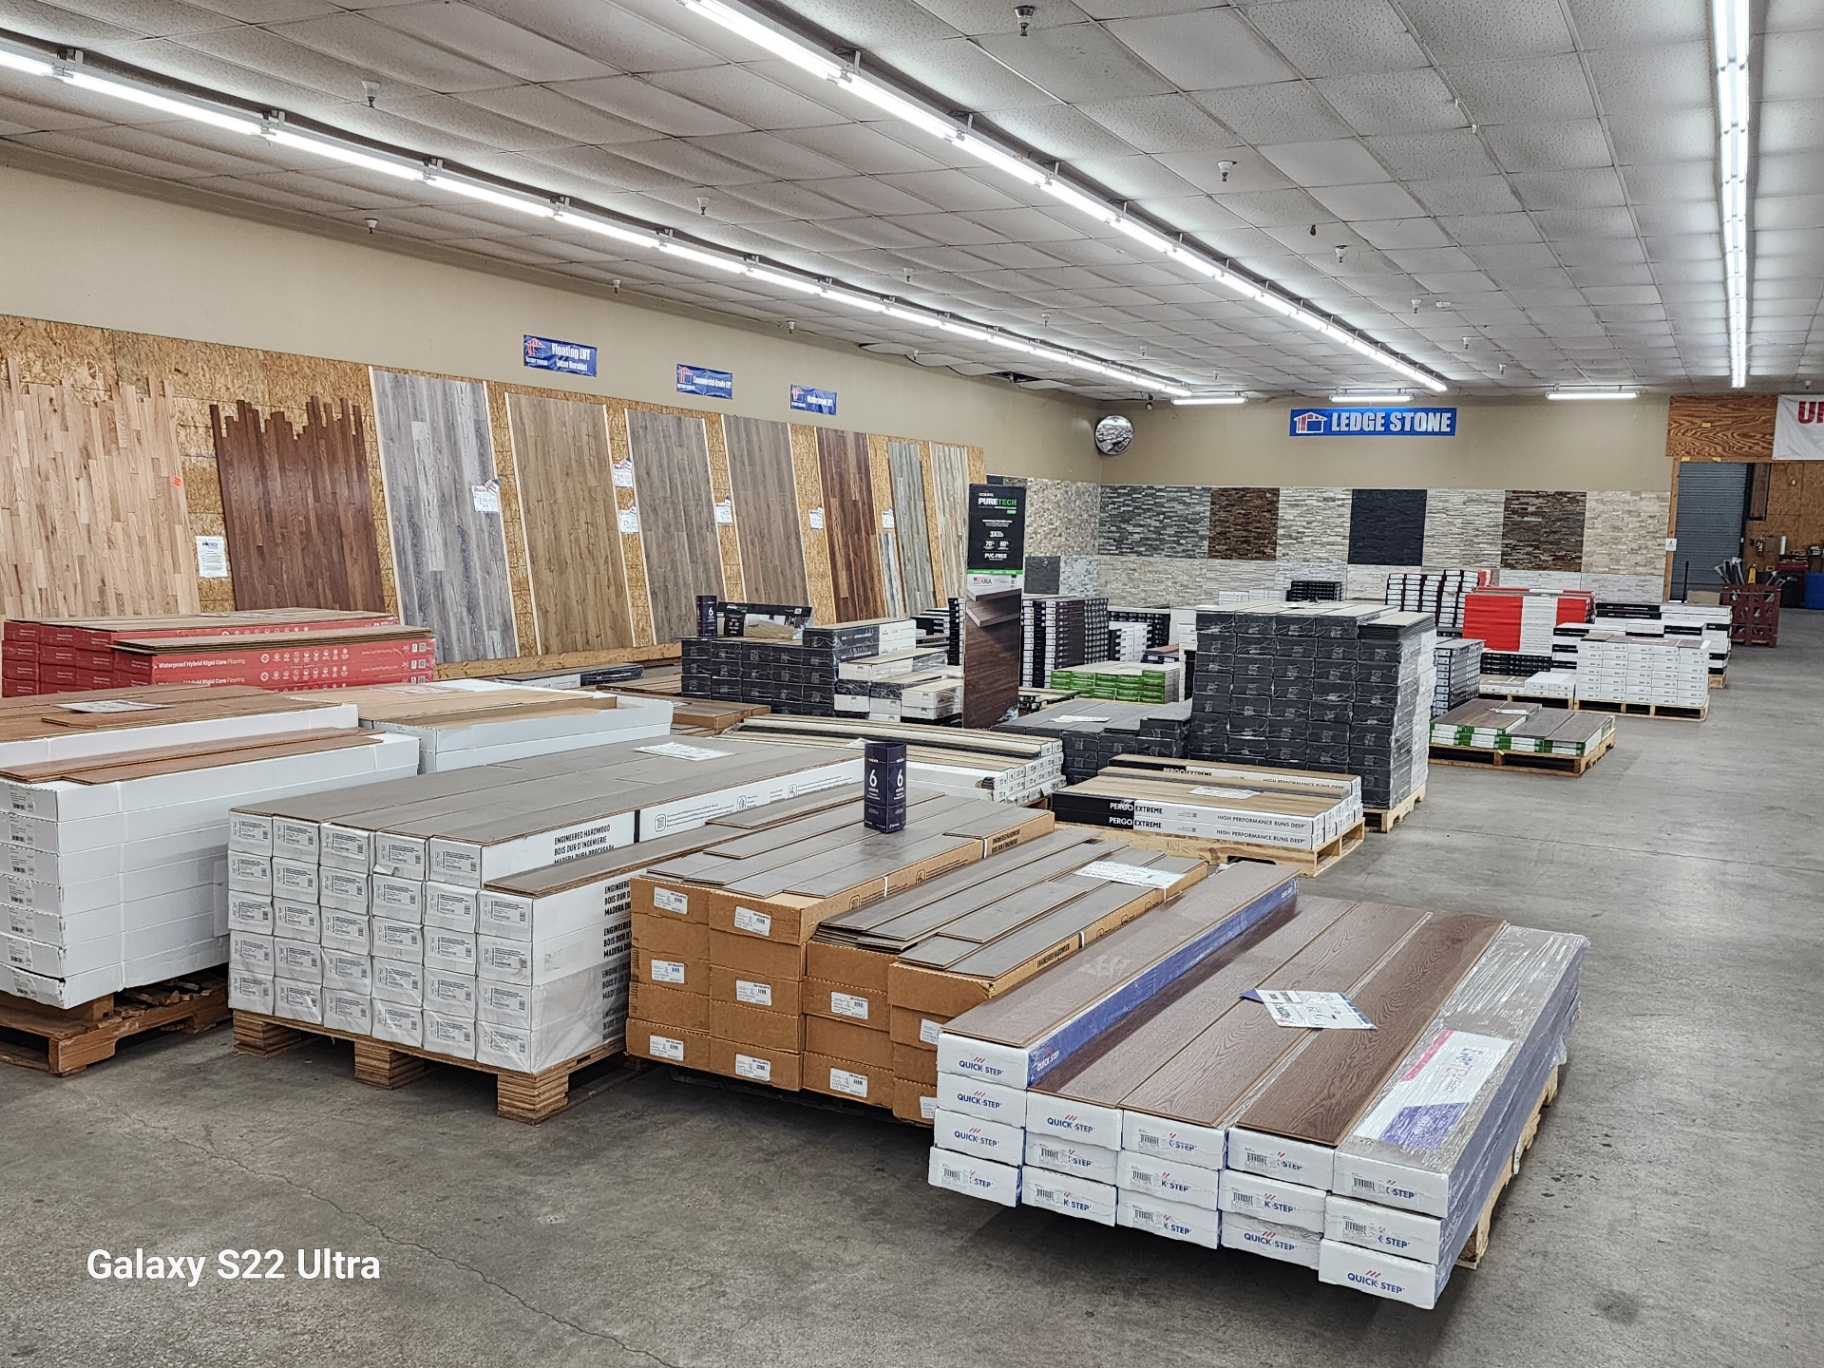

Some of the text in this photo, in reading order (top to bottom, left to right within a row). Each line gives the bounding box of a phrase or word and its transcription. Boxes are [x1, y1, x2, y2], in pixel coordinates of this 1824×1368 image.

[552, 343, 579, 360] Floating
[1331, 412, 1452, 433] LEDGE STONE
[158, 661, 186, 670] Waterproof
[186, 660, 202, 668] Hybrid
[869, 768, 878, 787] 6
[896, 768, 904, 787] 6
[1135, 805, 1163, 815] EXTREME
[1108, 817, 1162, 829] PERGO EXTREME
[1232, 816, 1272, 826] PERFORMANCE
[555, 824, 610, 845] ENGINEERED HARDWOOD
[1231, 831, 1271, 841] PERFORMANCE
[555, 846, 566, 856] BOIS
[567, 843, 576, 853] DUR
[605, 880, 630, 894] ENGINEERE
[605, 895, 616, 906] BOIS
[616, 892, 626, 902] DUR
[604, 903, 624, 917] MADERA
[603, 937, 616, 947] BOIS
[603, 945, 623, 959] MADERA
